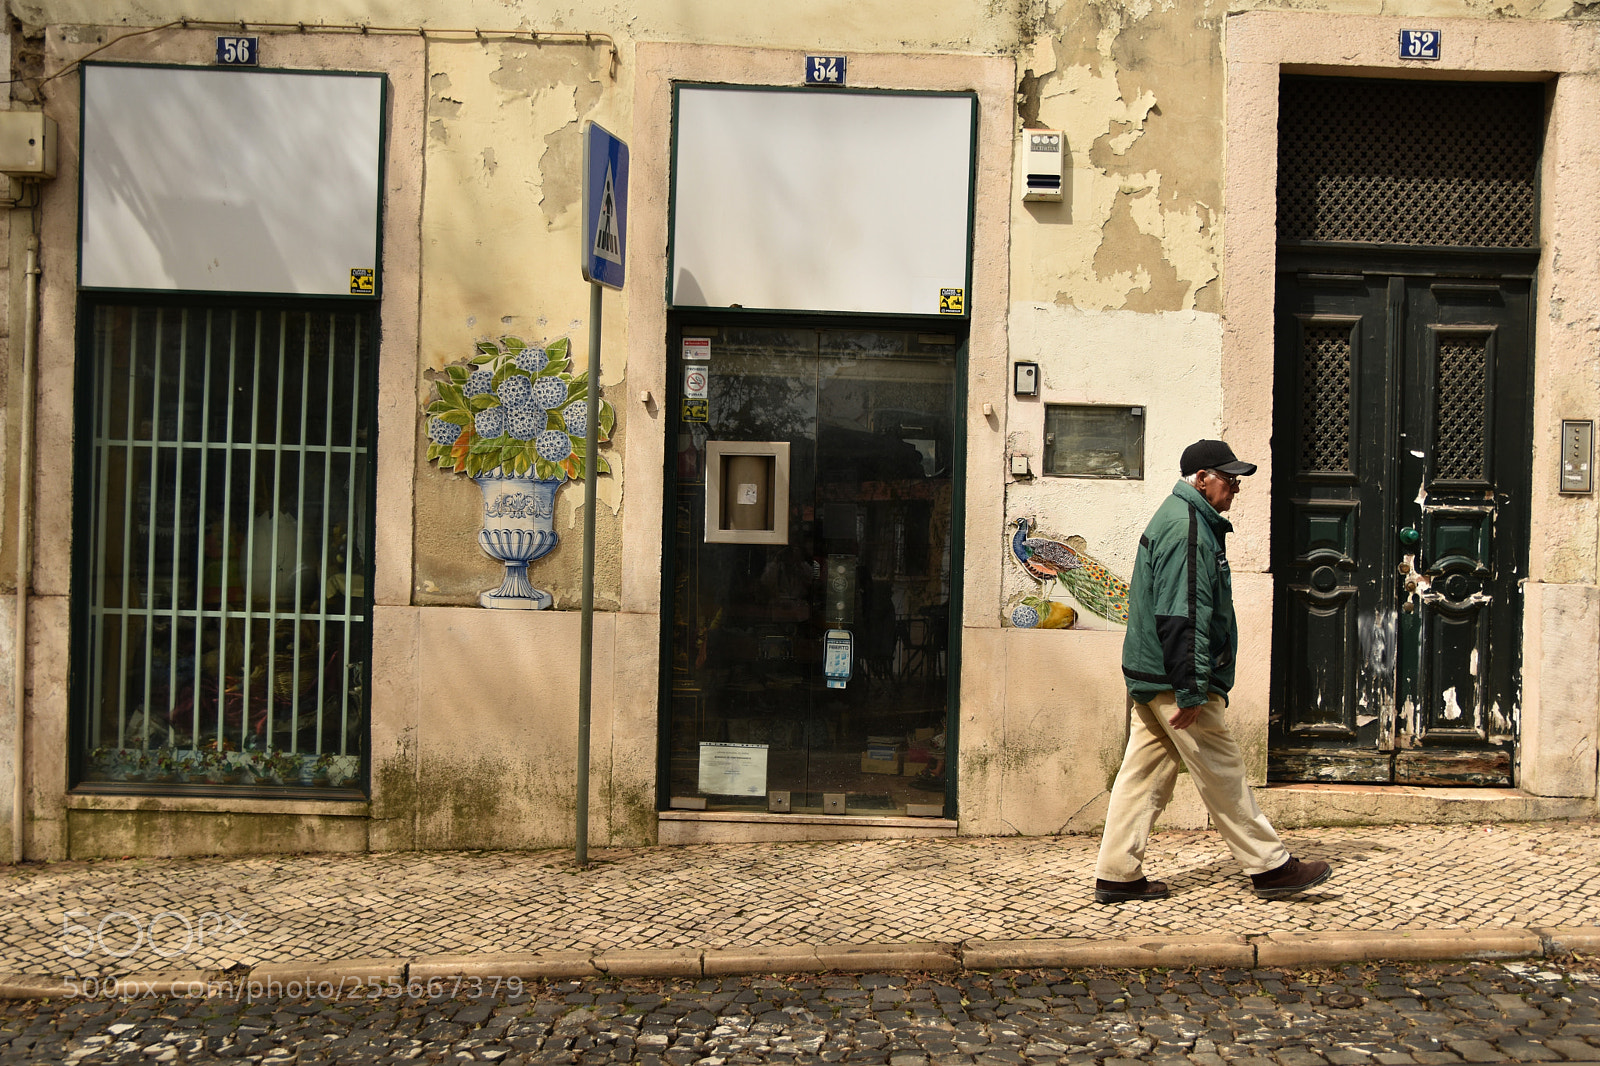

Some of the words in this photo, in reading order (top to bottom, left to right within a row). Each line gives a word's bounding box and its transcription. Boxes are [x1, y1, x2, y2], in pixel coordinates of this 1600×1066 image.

[224, 38, 249, 63] 56
[1408, 31, 1434, 56] 52
[813, 57, 839, 82] 54
